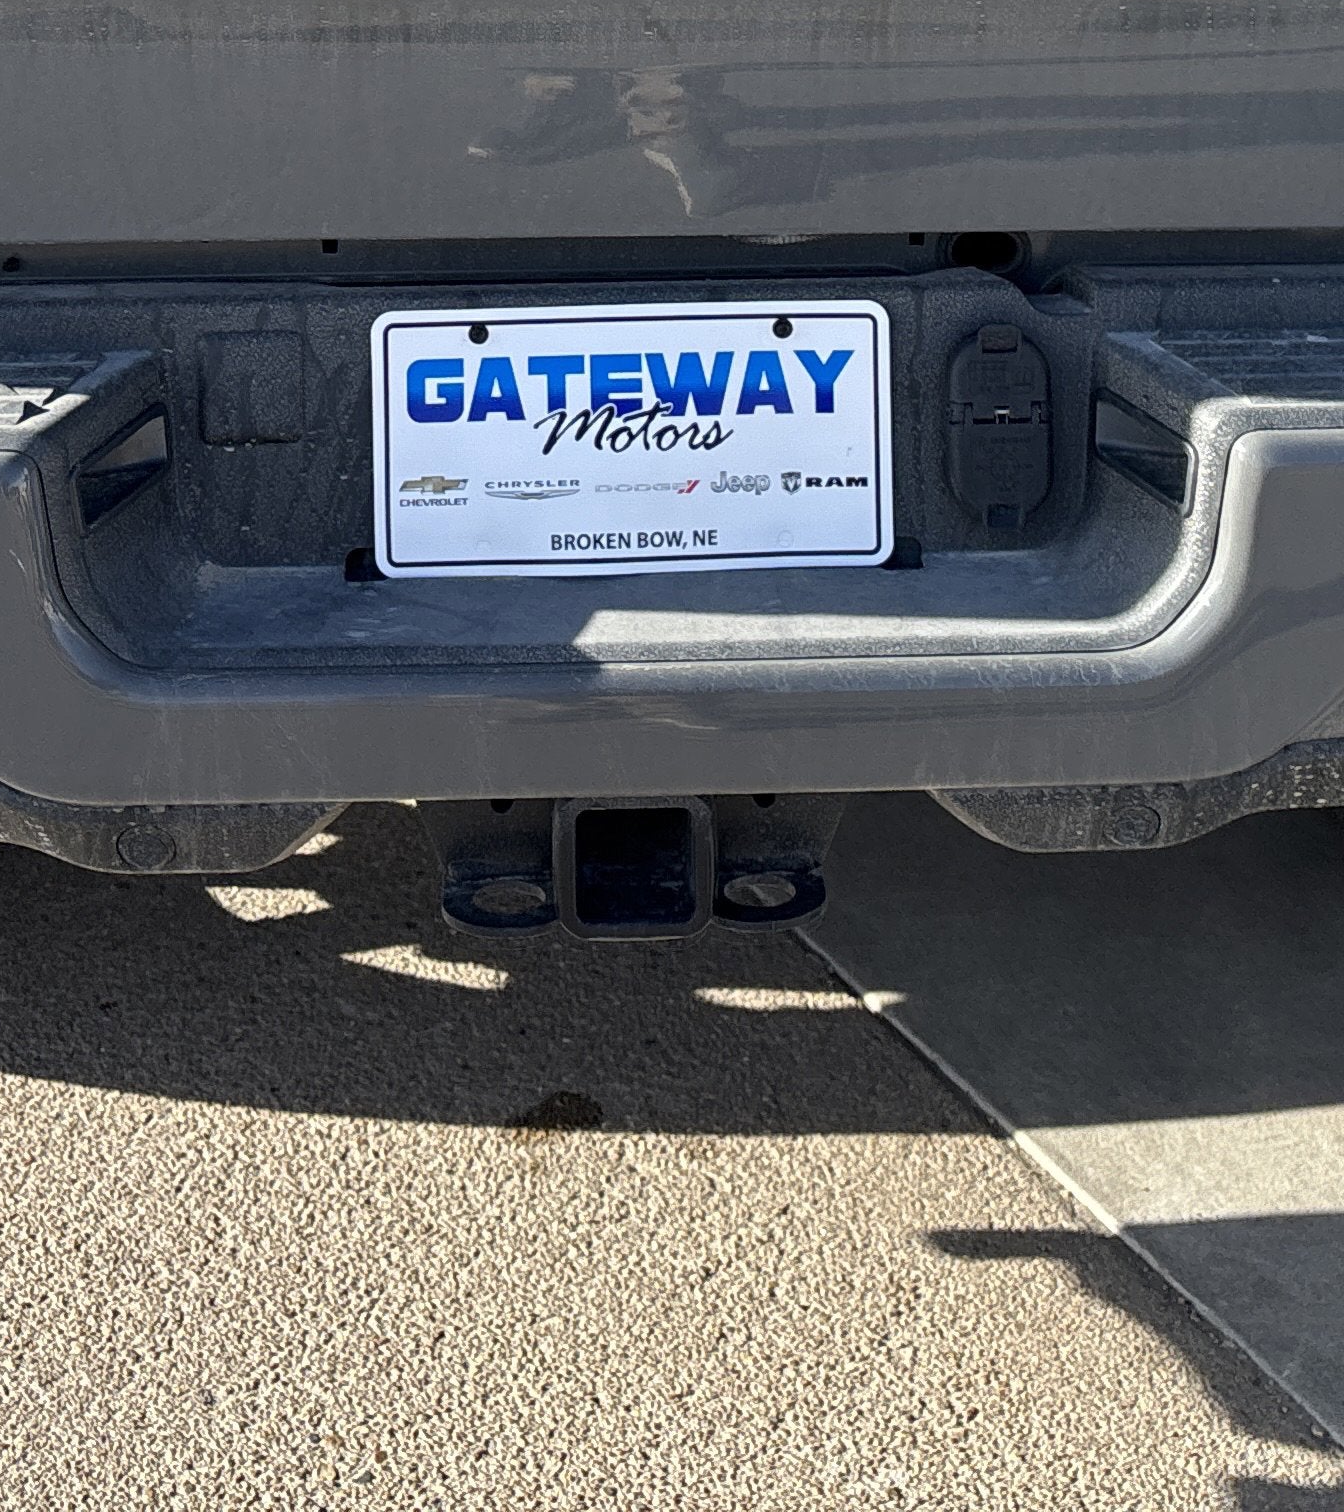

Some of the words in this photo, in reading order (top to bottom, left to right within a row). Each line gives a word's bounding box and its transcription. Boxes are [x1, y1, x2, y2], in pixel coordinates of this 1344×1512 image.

[406, 349, 855, 423] GATEWAY
[533, 401, 734, 455] Motors
[484, 479, 581, 489] CHRYSLER
[594, 483, 687, 493] DODGE
[710, 471, 771, 495] Jeep
[805, 476, 869, 488] RAM
[399, 497, 469, 508] CHEVROLET
[550, 532, 632, 551] BROKEN
[637, 530, 688, 550] BOW,
[693, 529, 719, 546] NE
